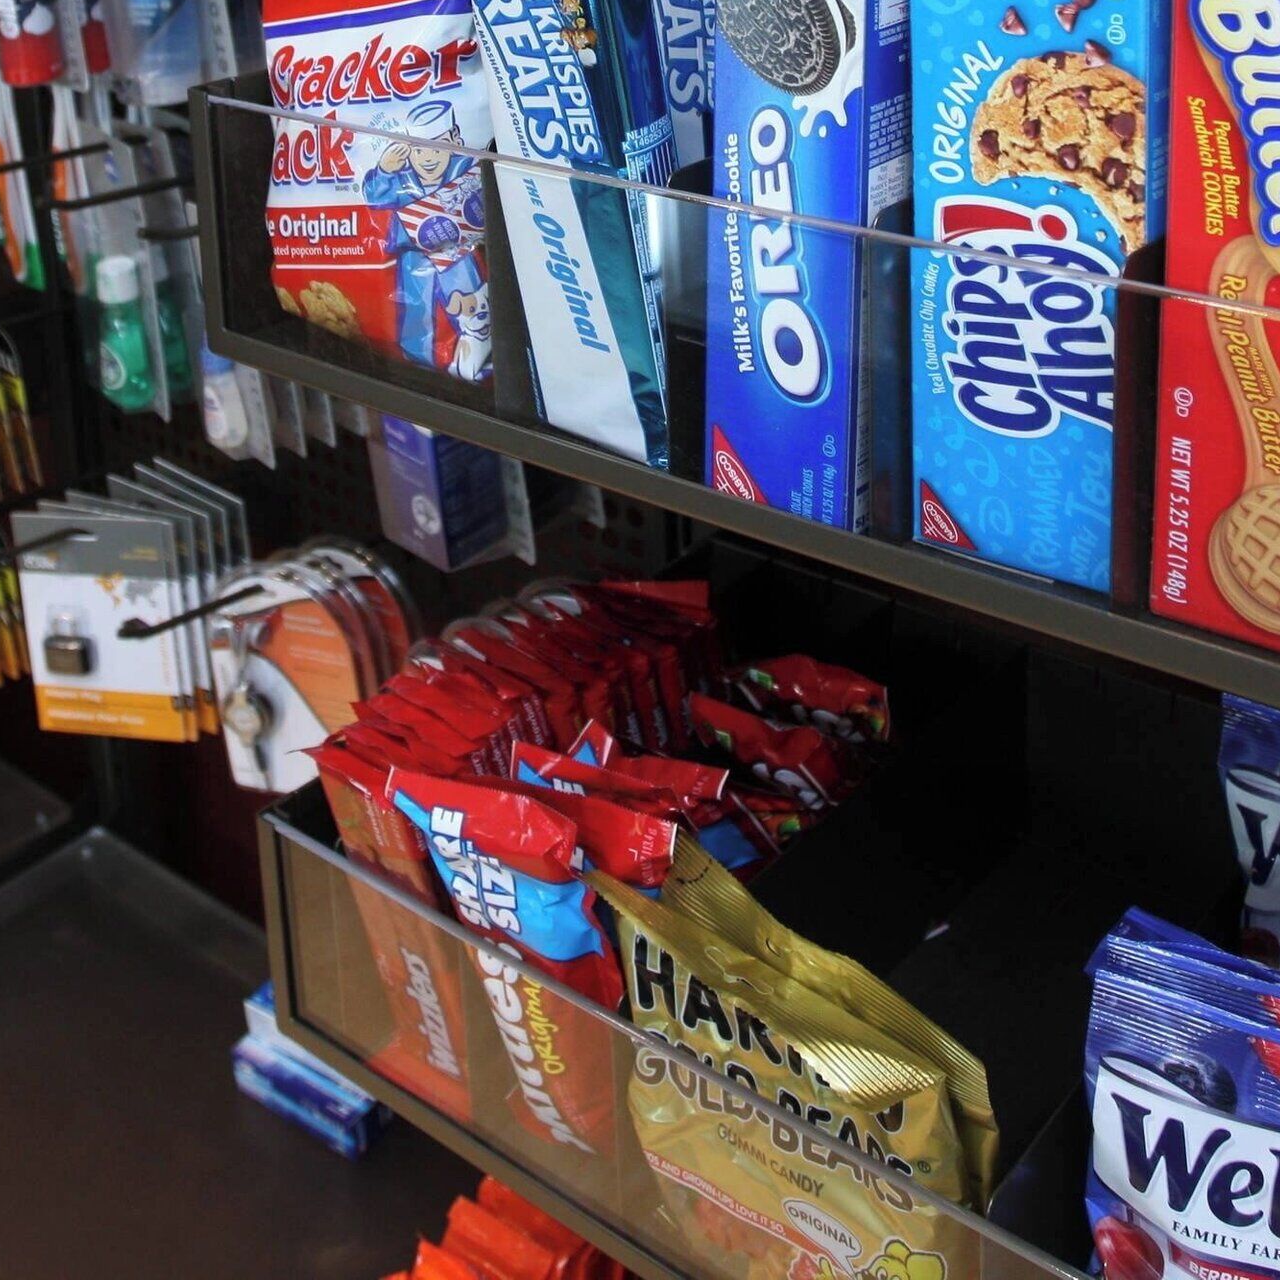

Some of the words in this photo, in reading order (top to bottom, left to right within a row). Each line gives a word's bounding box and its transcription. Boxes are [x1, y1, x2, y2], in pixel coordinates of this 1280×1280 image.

[269, 33, 478, 110] Cracker
[478, 29, 515, 112] MARSHMALLOW
[509, 112, 530, 158] SQUARES
[531, 6, 600, 158] KRISPIES
[928, 39, 1005, 184] ORIGINAL
[272, 108, 357, 186] ack
[725, 132, 743, 204] Cookie
[1186, 96, 1213, 162] Sandwich
[1203, 169, 1224, 237] COOKIES
[1213, 120, 1232, 169] Peanut
[522, 178, 545, 208] THE
[1220, 172, 1240, 220] Butter
[278, 211, 358, 242] Original
[291, 246, 322, 260] popcorn
[324, 246, 331, 257] &
[332, 245, 366, 259] peanuts
[747, 108, 822, 398] OREO
[532, 212, 613, 354] Original
[723, 216, 746, 304] Favorite
[922, 262, 940, 299] Cookies
[728, 308, 755, 373] Milk's
[919, 303, 936, 322] Chip
[946, 242, 1054, 434] Chips
[924, 324, 941, 368] Chocolate
[1220, 330, 1265, 407] Peanut
[932, 370, 945, 395] Real
[1171, 436, 1193, 458] NET
[718, 454, 753, 501] NABISCO
[1170, 461, 1192, 490] WT
[923, 501, 958, 544] NABISCO
[1169, 494, 1190, 527] 5.25
[1168, 531, 1189, 552] OZ
[1162, 554, 1189, 605] (148g)
[429, 806, 492, 932] SHARE
[468, 850, 521, 936] SIZE
[633, 932, 905, 1133] HAR
[717, 1122, 767, 1166] GUMMI
[769, 1157, 825, 1198] CANDY
[661, 1159, 681, 1178] AND
[682, 1169, 735, 1209] GROWN-UPS
[735, 1201, 759, 1220] LOVE
[787, 1205, 857, 1251] ORIGINAL
[1171, 1219, 1244, 1252] FAMILY
